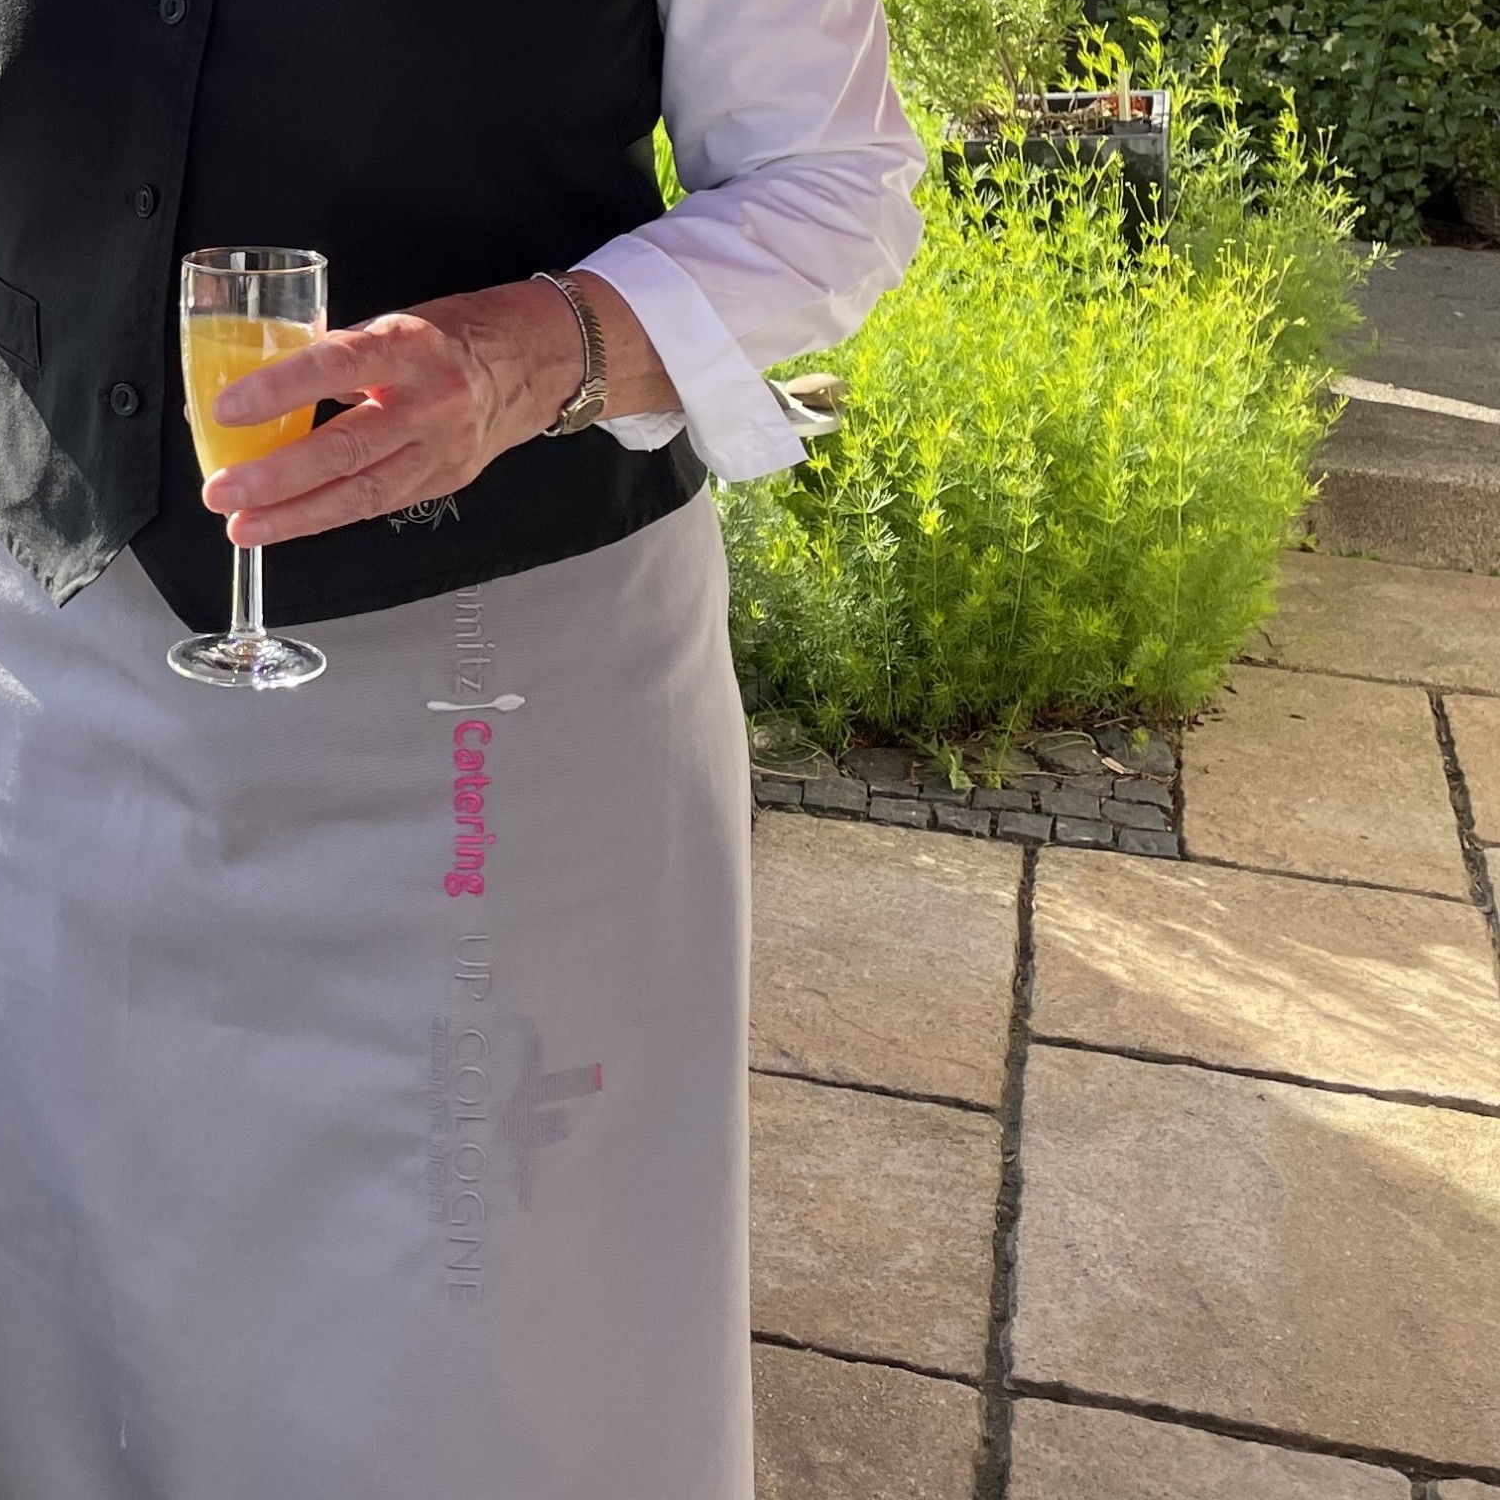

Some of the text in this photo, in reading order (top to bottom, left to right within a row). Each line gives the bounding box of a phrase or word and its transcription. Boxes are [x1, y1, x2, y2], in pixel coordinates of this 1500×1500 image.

[444, 719, 497, 897] Catering
[445, 934, 490, 1300] UP COLOGNE
